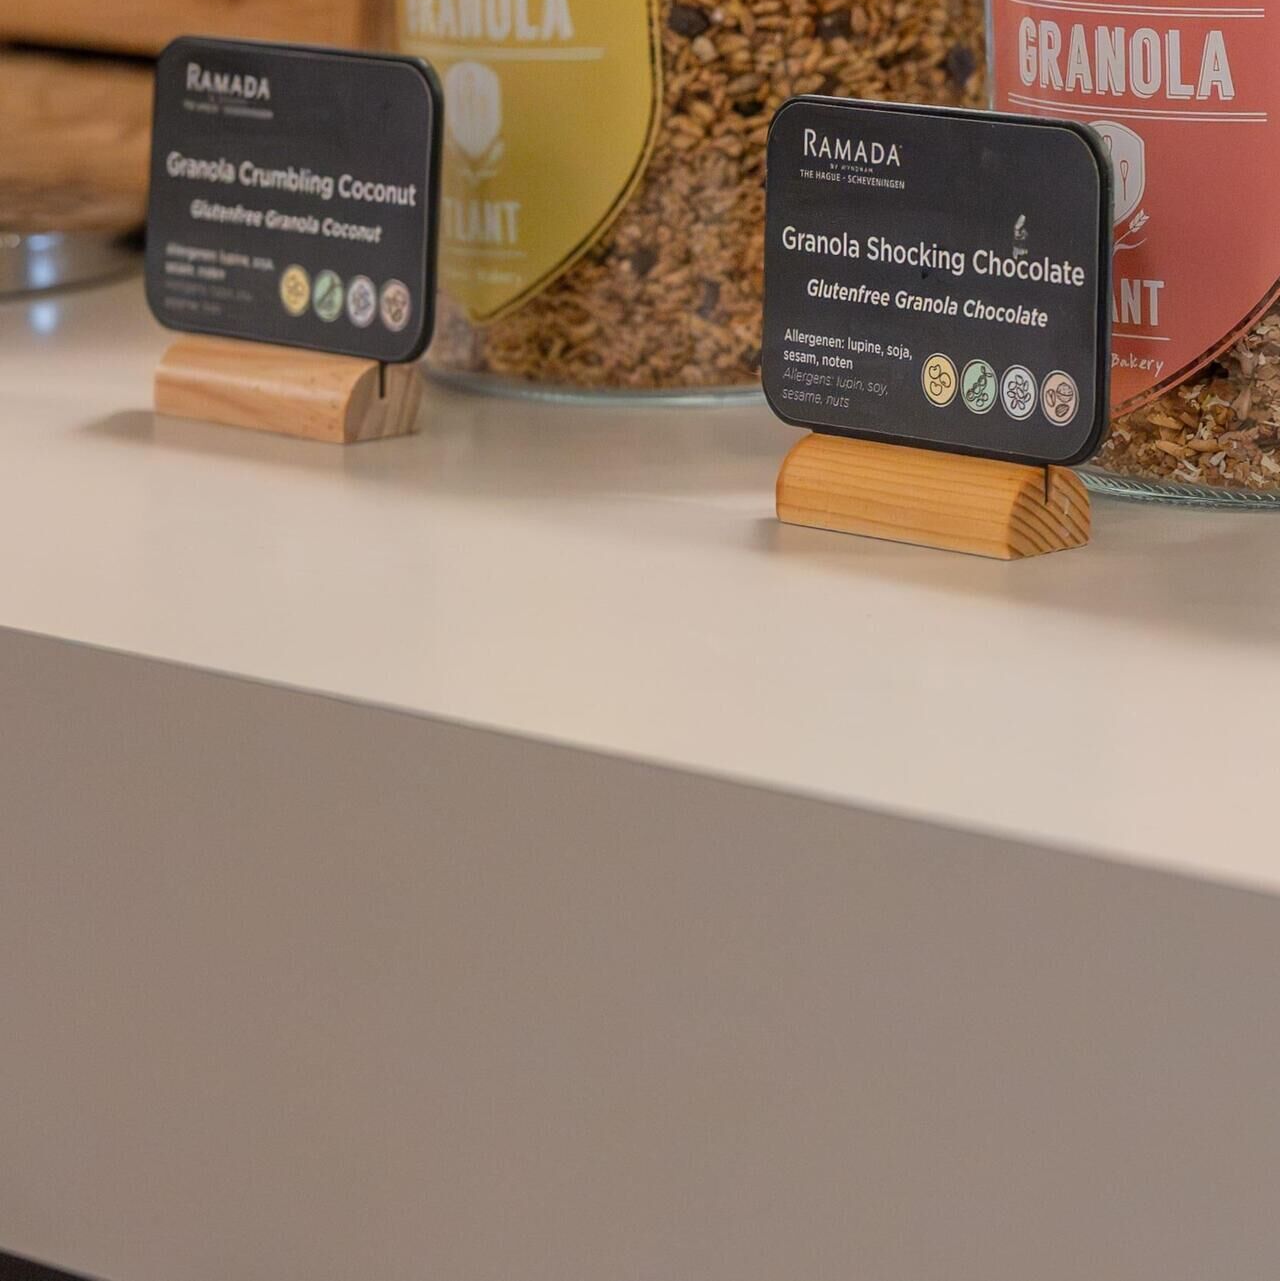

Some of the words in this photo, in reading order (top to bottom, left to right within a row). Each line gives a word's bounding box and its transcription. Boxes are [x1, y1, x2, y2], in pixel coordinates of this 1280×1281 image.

[1018, 16, 1235, 101] GRANOLA
[186, 61, 271, 101] RAMADA
[804, 128, 901, 167] RAMADA
[166, 151, 236, 184] Granola
[239, 160, 334, 200] Crumbling
[338, 174, 417, 207] Coconut
[800, 169, 814, 179] THE
[815, 171, 841, 182] HAGUE
[847, 174, 905, 189] SCHEVENINGEN
[190, 198, 263, 227] Glutenfree
[264, 208, 319, 235] Granola
[322, 217, 382, 244] Coconut
[782, 225, 859, 258] Granola
[867, 236, 965, 276] Shocking
[972, 250, 1085, 287] Chocolate
[807, 278, 890, 306] Glutenfree
[895, 290, 958, 316] Granola
[963, 299, 1048, 328] Chocolate
[783, 350, 819, 366] sesam,
[822, 355, 853, 369] noten
[784, 328, 845, 349] Allergenen:
[847, 337, 884, 356] lupine,
[887, 344, 912, 360] soja,
[782, 367, 834, 386] Allergens:
[836, 376, 864, 391] lupin,
[867, 381, 888, 396] soy,
[1111, 352, 1164, 377] Bakery
[782, 388, 823, 405] sesame,
[825, 395, 850, 408] nuts
